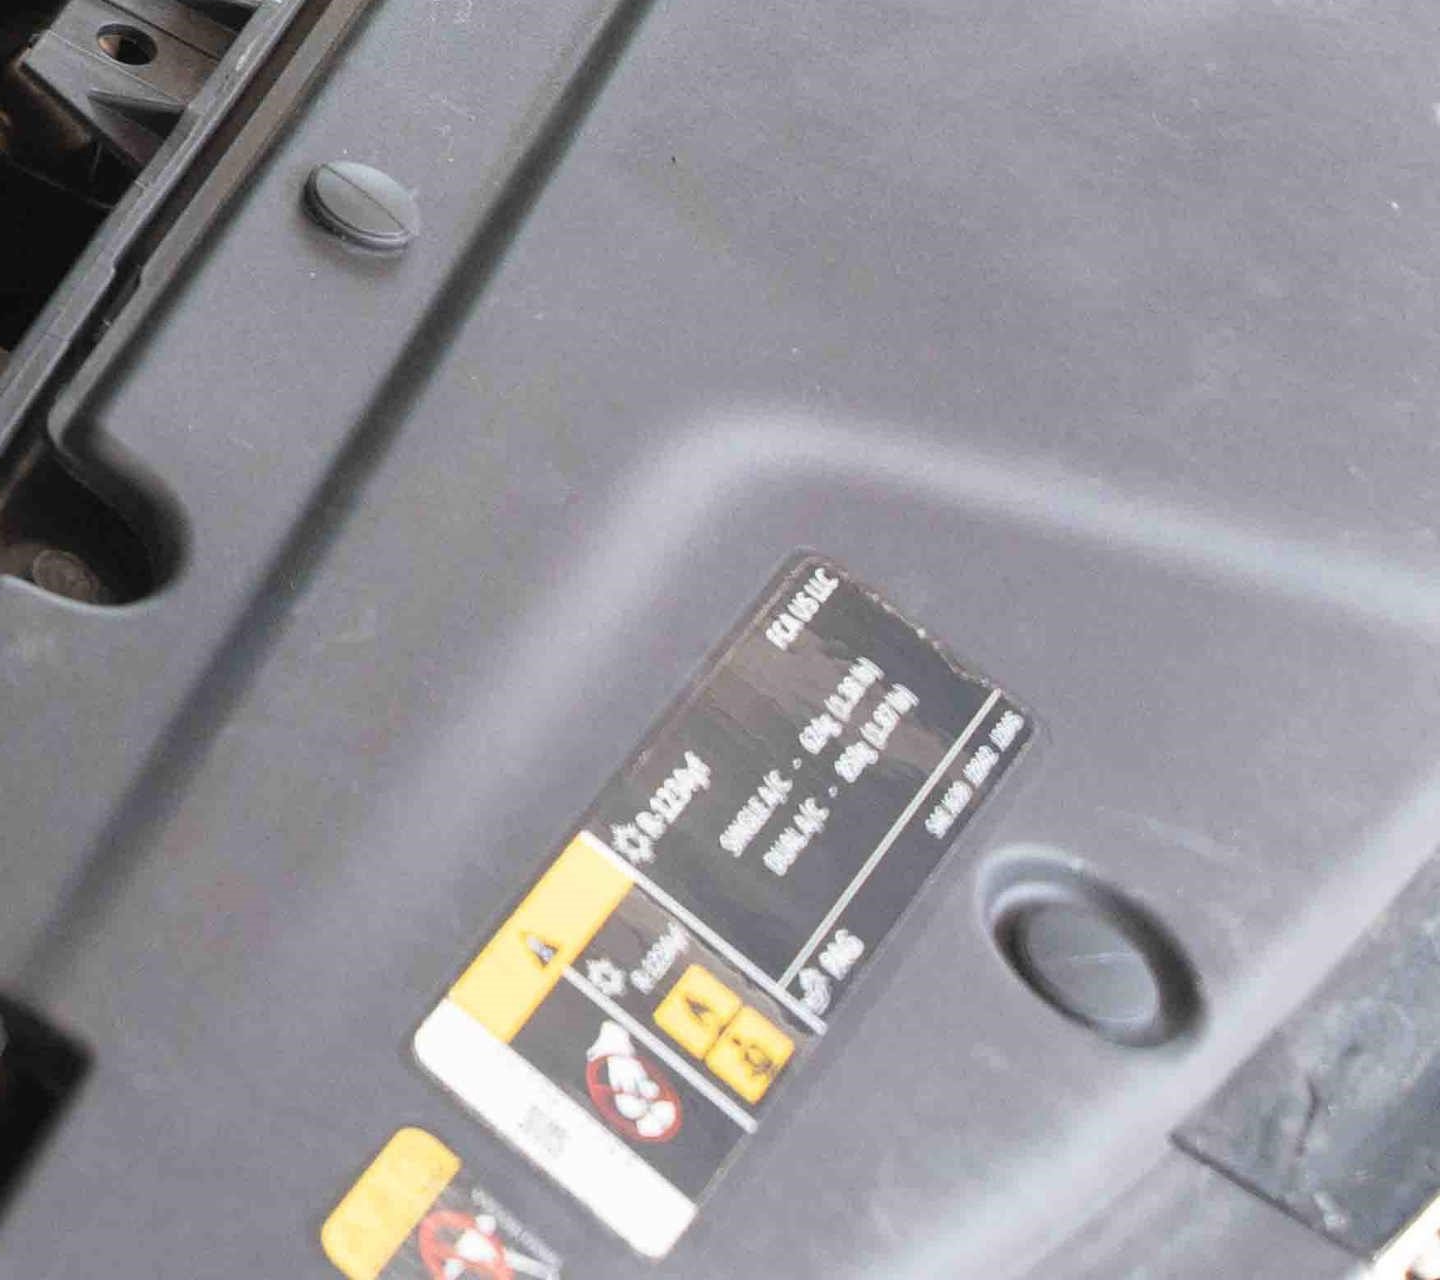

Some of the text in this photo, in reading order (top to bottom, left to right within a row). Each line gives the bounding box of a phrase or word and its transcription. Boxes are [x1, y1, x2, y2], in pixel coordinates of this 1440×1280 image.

[765, 567, 839, 651] FCA US LLC
[719, 795, 775, 858] SINGLE
[757, 769, 793, 811] A/C
[762, 827, 810, 877] DUAL
[793, 797, 830, 839] A/C
